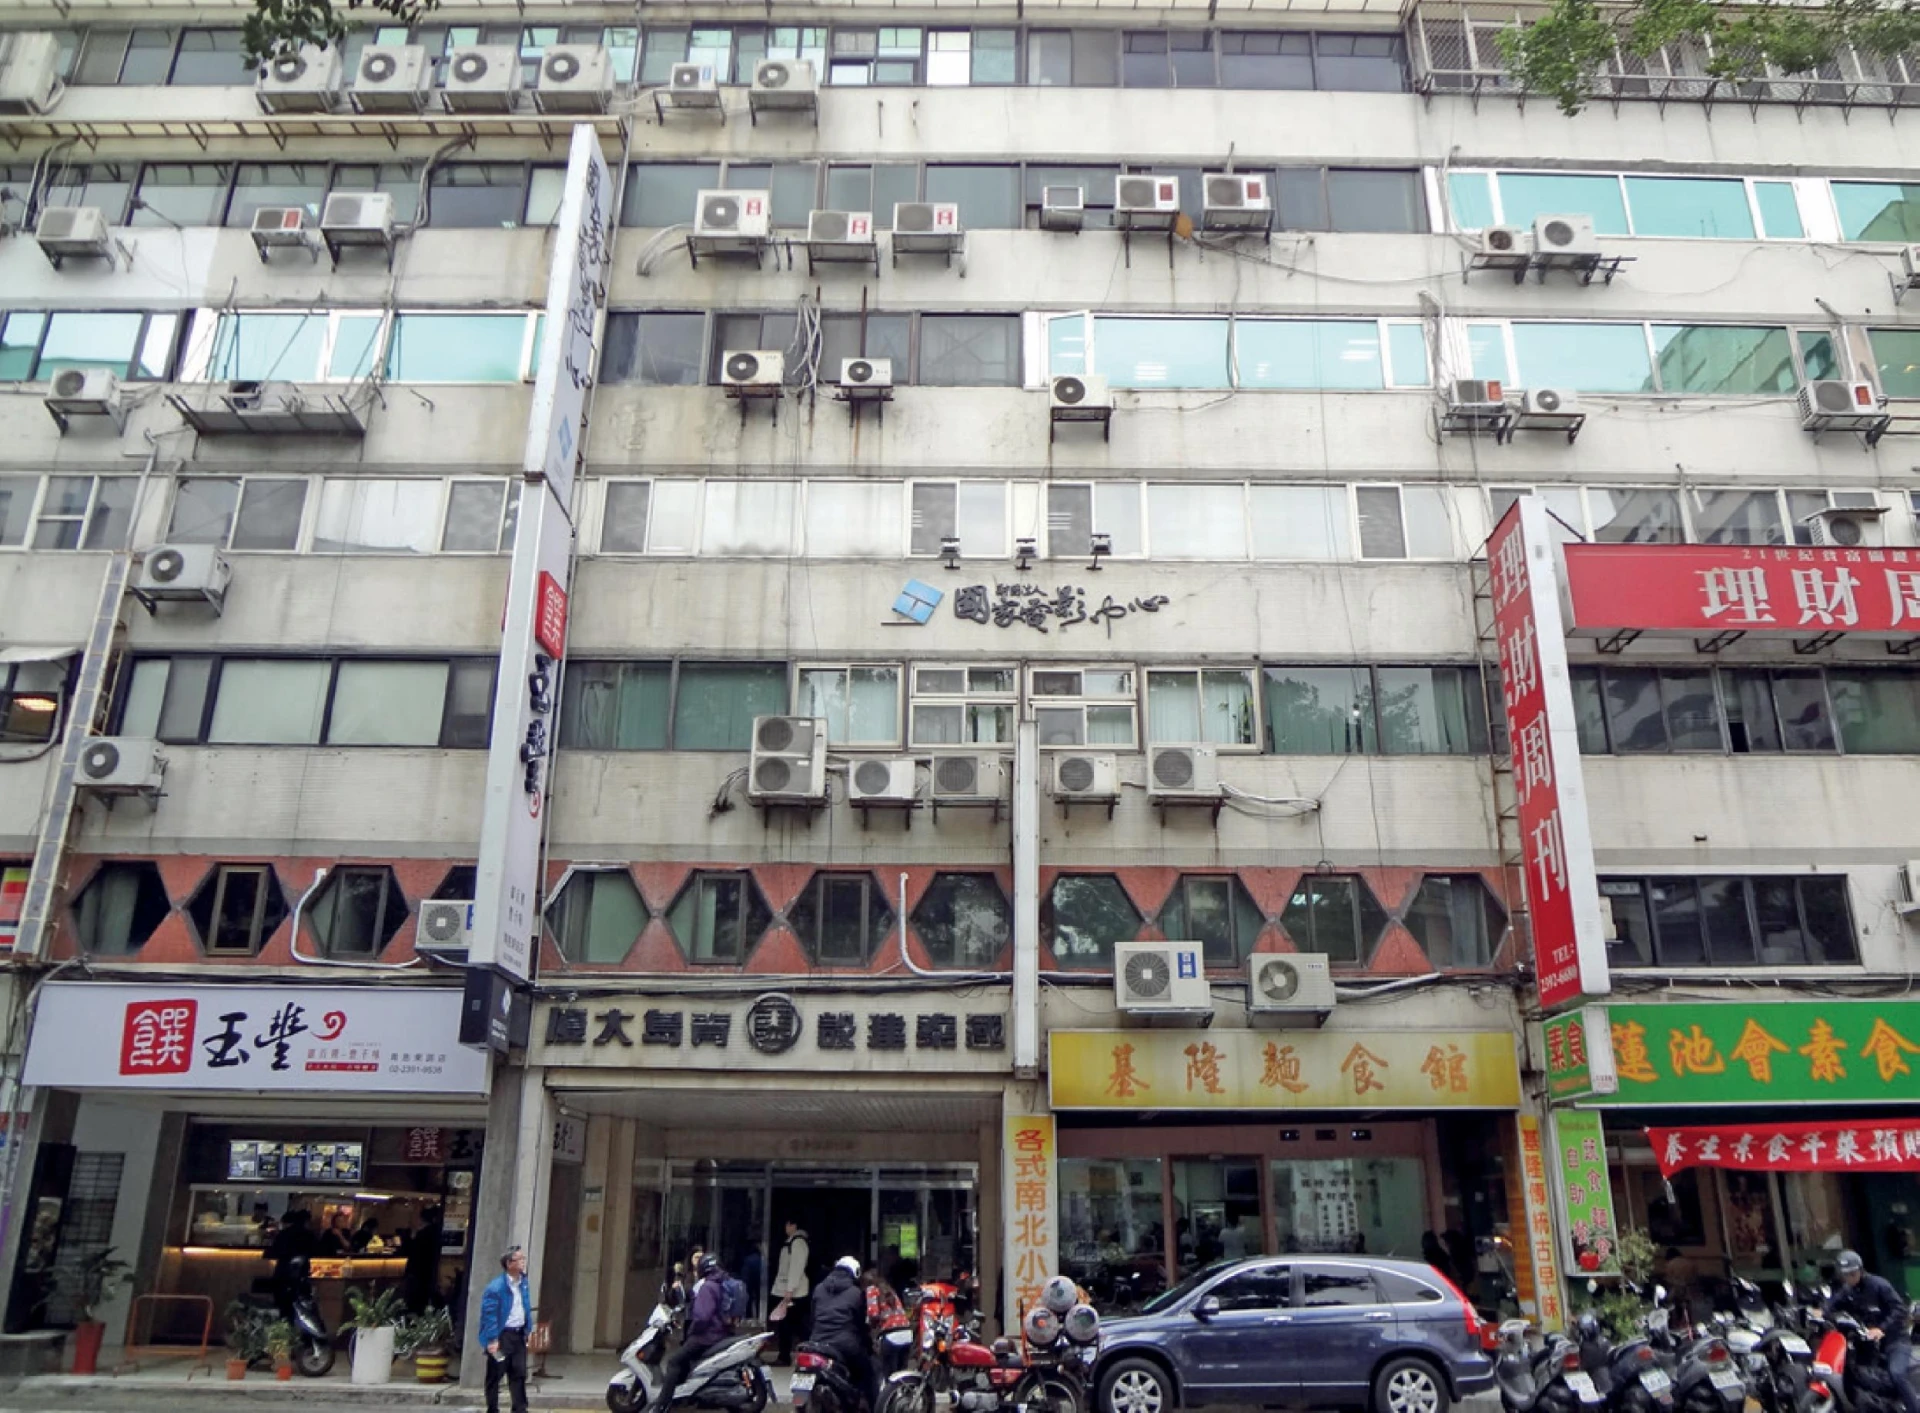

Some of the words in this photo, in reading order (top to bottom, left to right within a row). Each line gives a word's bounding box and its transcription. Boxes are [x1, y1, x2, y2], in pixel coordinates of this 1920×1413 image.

[955, 584, 1170, 640] 國家電影中心
[1498, 521, 1566, 901] 理財周刊
[1552, 943, 1574, 965] TEL:
[1105, 1041, 1470, 1098] 基隆麵食館
[1547, 1020, 1587, 1072] 素食
[1523, 1129, 1560, 1320] 基隆傳統古早味
[1566, 1147, 1590, 1247] 自助餐
